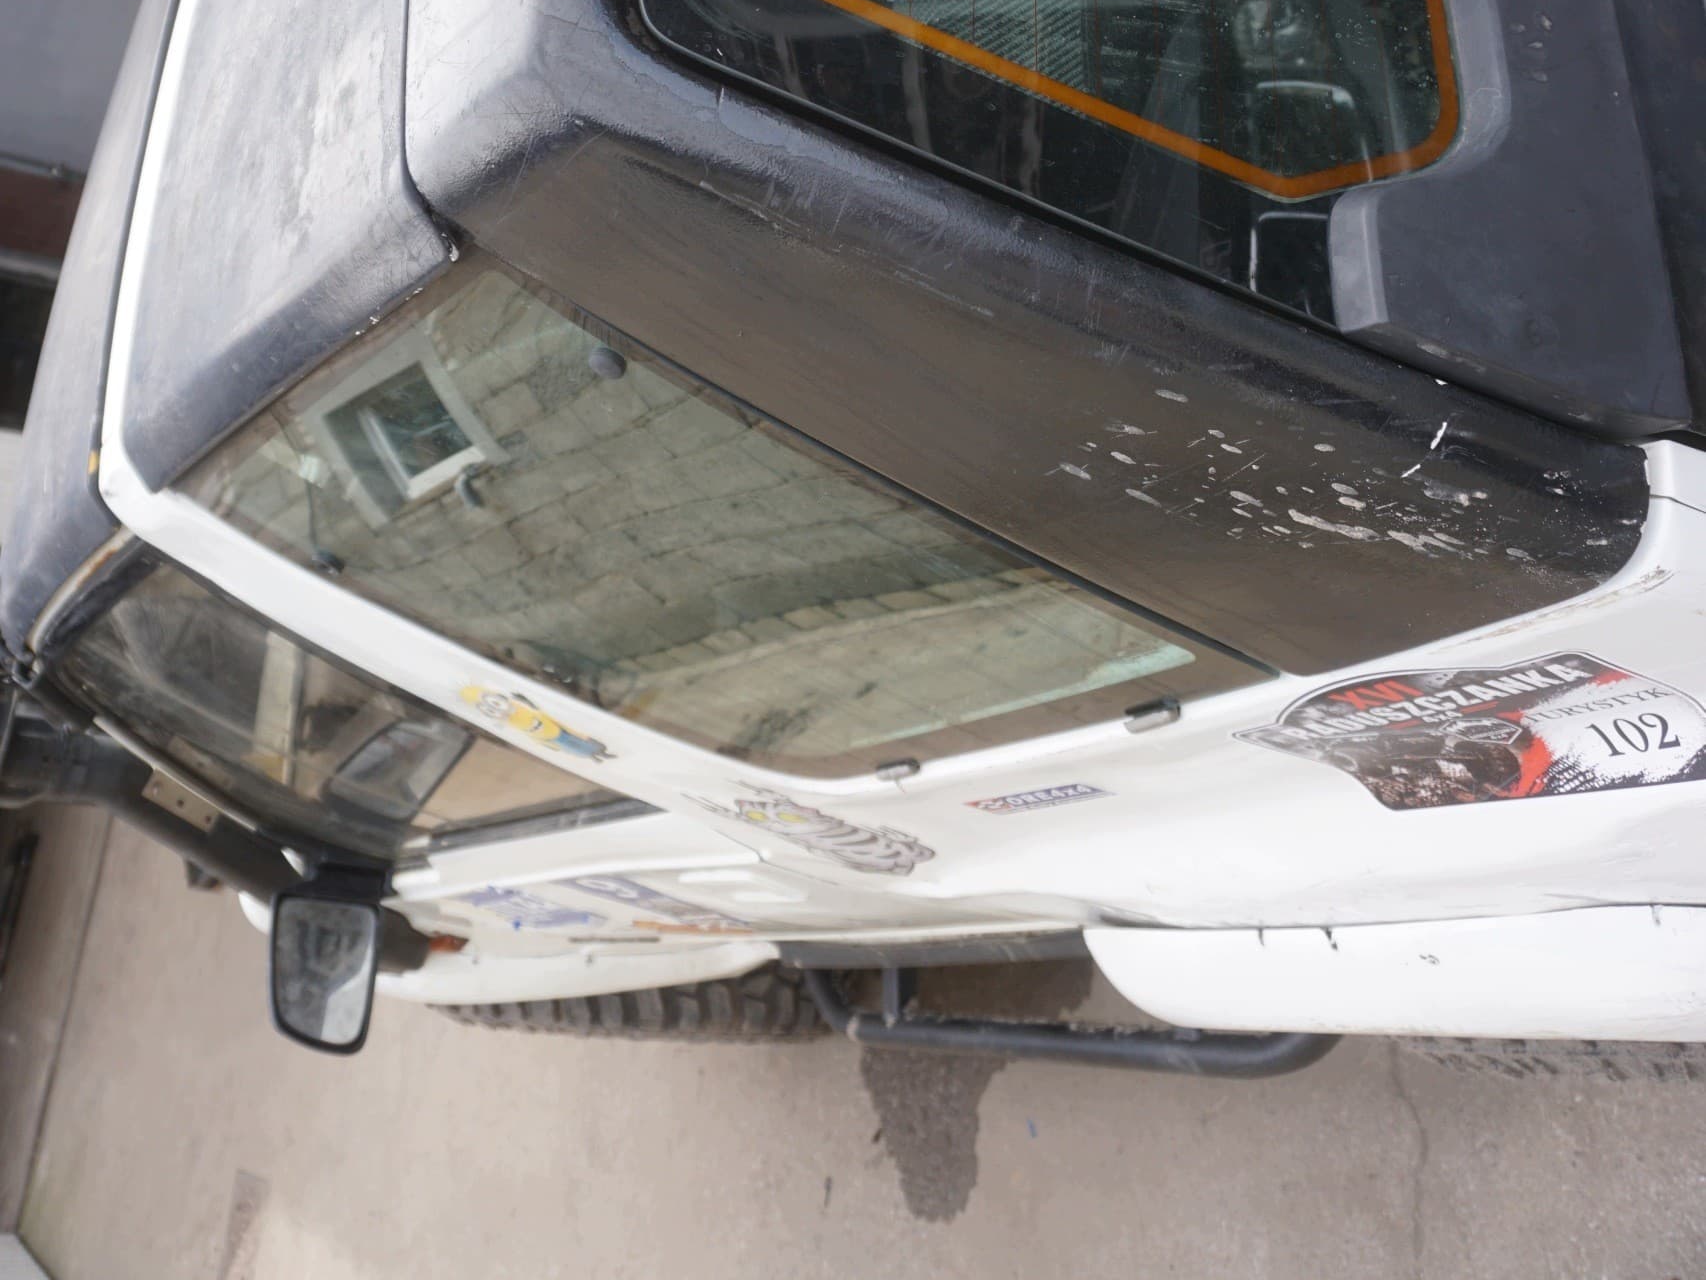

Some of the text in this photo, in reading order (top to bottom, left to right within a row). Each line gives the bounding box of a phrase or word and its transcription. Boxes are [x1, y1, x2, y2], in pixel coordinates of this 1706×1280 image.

[1279, 662, 1593, 740] RADUSZCZANKA
[1327, 680, 1424, 710] XVI
[1524, 687, 1675, 723] TURYSTYK
[1584, 712, 1682, 758] 102
